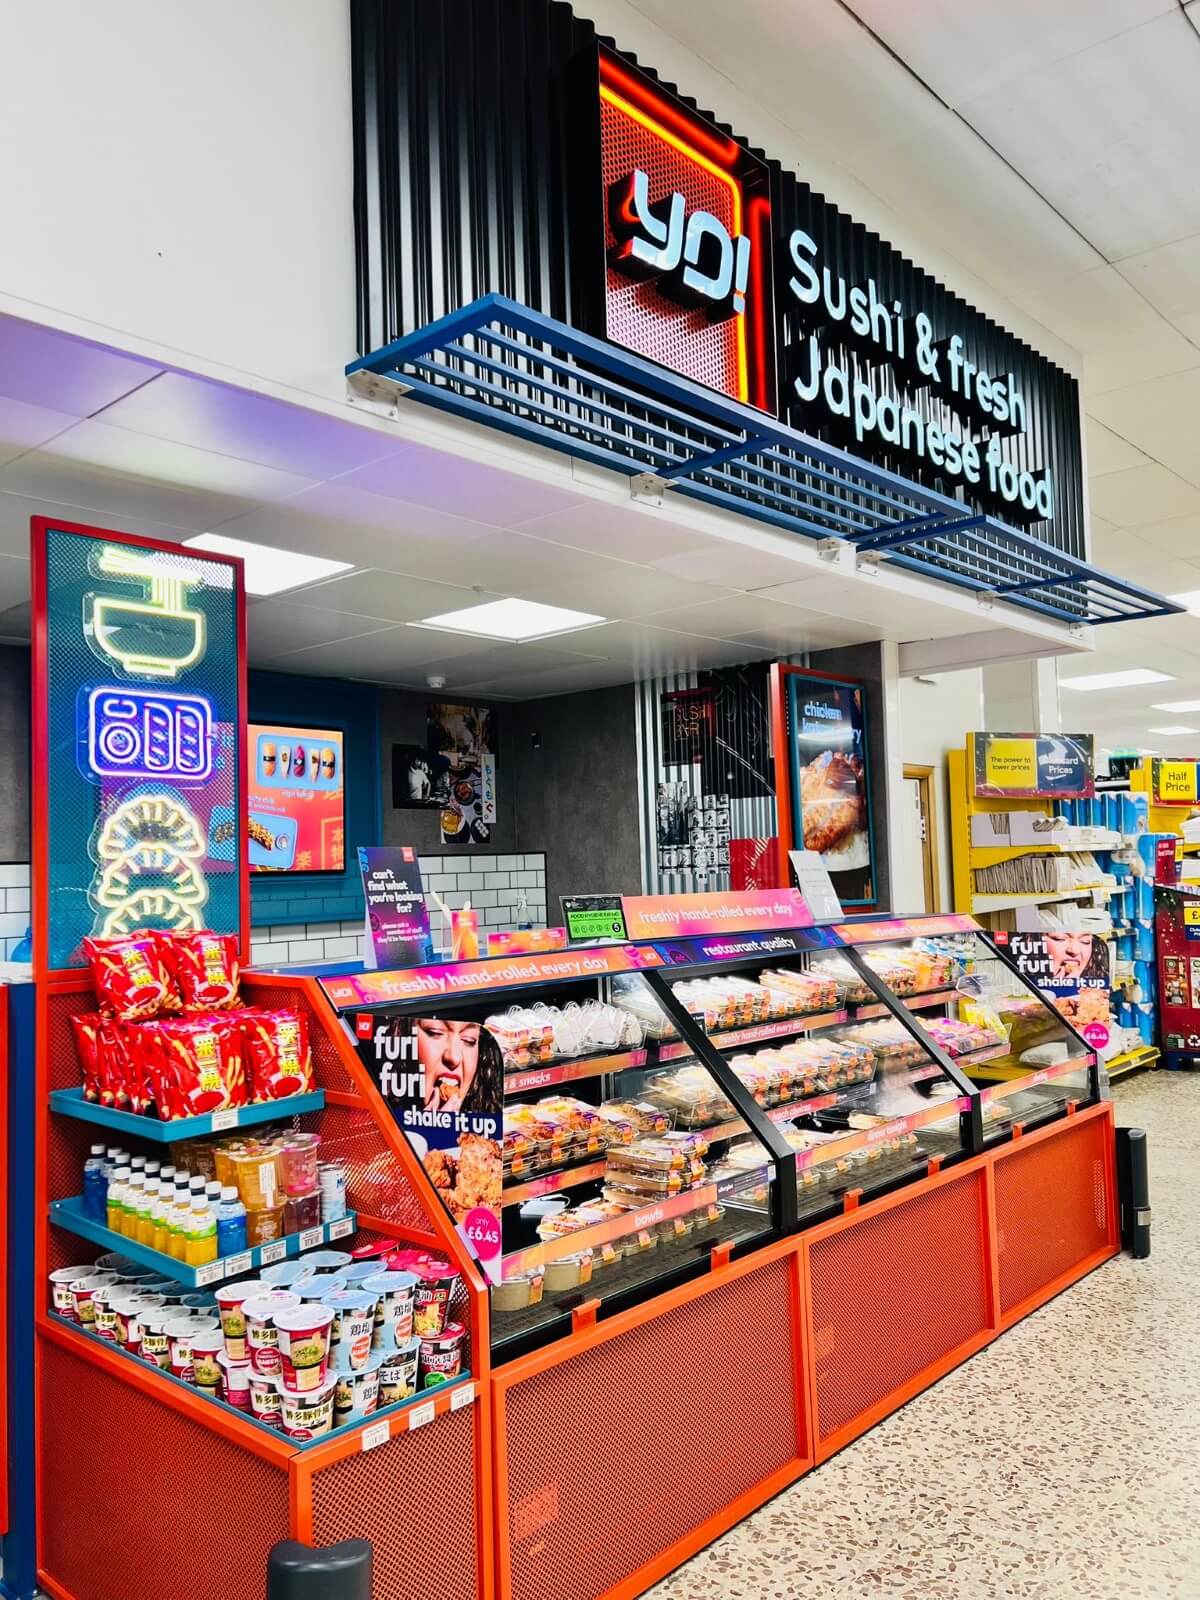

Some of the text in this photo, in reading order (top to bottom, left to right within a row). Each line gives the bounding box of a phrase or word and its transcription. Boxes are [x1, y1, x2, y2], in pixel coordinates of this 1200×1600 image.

[789, 230, 1027, 433] Sushi & fresh
[795, 335, 1054, 520] Japanese food
[804, 700, 842, 720] chicken
[1004, 757, 1023, 765] power
[1048, 765, 1073, 774] Prices
[1168, 771, 1187, 781] Half
[1165, 782, 1191, 792] Price
[372, 869, 395, 880] can't
[367, 880, 408, 891] find what
[368, 890, 423, 906] you're looking
[396, 902, 412, 914] for?
[639, 901, 792, 924] freshly hand-rolled every day
[702, 936, 797, 957] restaurant quality
[1010, 936, 1048, 955] furi
[1017, 955, 1054, 973] furi
[383, 956, 609, 994] freshly hand-rolled every day
[1038, 976, 1105, 989] shake it up
[775, 1023, 792, 1034] every
[374, 1026, 418, 1060] furi
[380, 1062, 426, 1098] furi
[509, 1081, 517, 1090] &
[519, 1071, 551, 1088] snacks
[403, 1105, 496, 1140] shake it up
[772, 1108, 789, 1122] lunch
[475, 1216, 489, 1228] only
[635, 1207, 663, 1227] bowls
[468, 1226, 499, 1244] £6.45
[379, 1370, 401, 1381] そば
